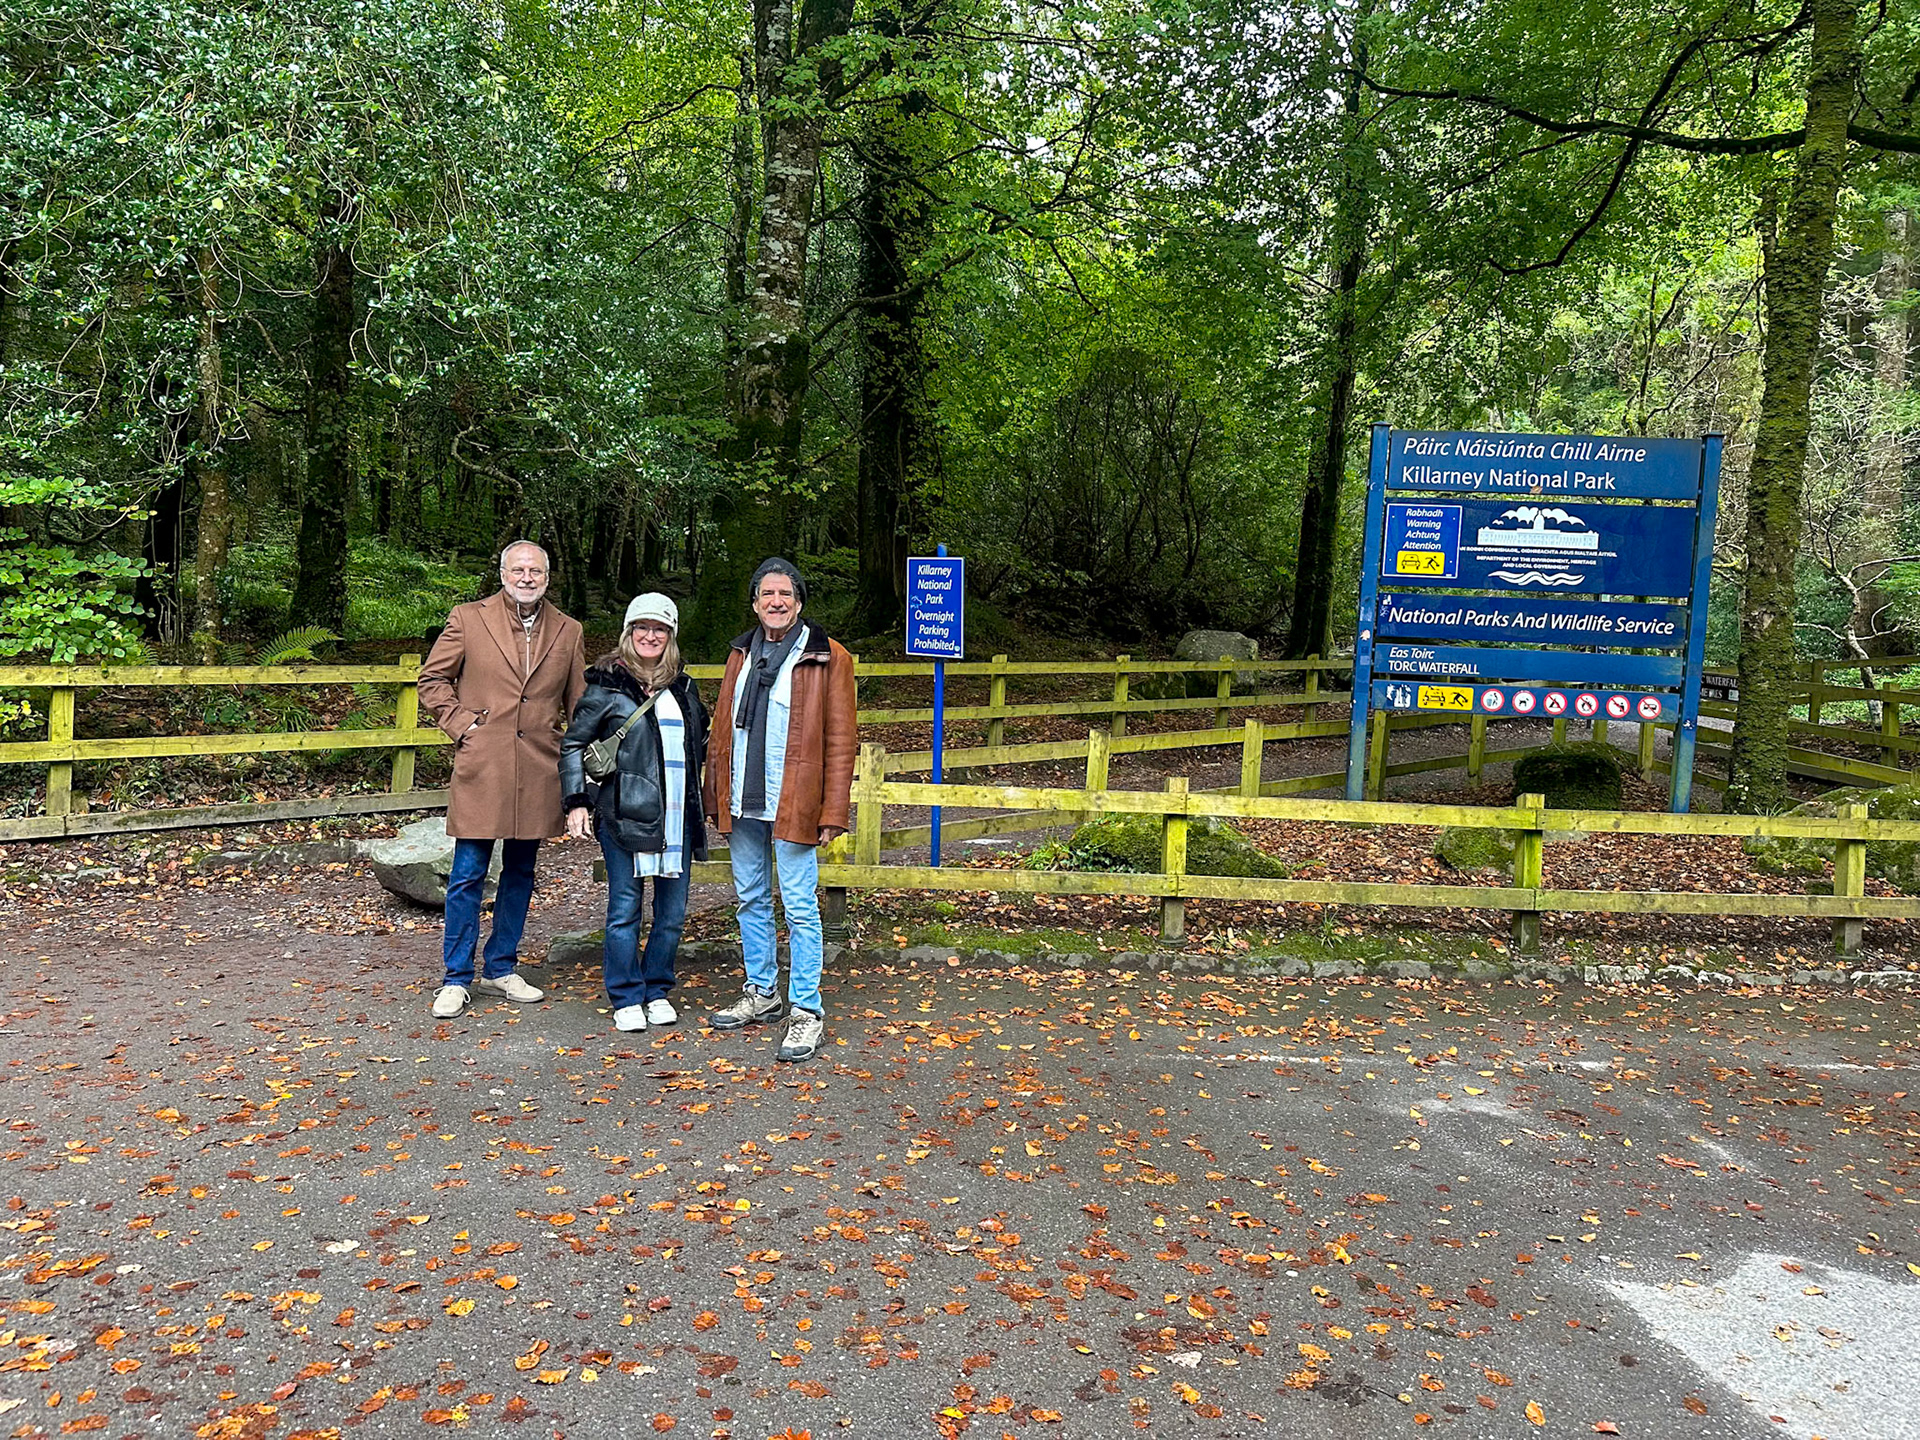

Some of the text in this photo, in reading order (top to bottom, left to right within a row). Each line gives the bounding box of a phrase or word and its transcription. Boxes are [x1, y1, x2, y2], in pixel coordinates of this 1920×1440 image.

[1403, 437, 1647, 462] Páirc Náisiúnta Chill Airne
[1402, 466, 1616, 490] Killarney National Park
[1406, 508, 1443, 518] Rabhadh
[1406, 519, 1442, 530] Warning
[1405, 530, 1440, 541] Achtung
[1402, 541, 1441, 551] Attention
[917, 564, 952, 578] Killarney
[917, 579, 952, 590] National
[925, 593, 944, 605] Park
[914, 609, 955, 624] Overnight
[1388, 607, 1675, 635] National Parks And Wildlife Service
[918, 624, 950, 638] Parking
[913, 637, 955, 651] Prohibited
[1389, 646, 1435, 659] Eas Toirc
[1388, 660, 1480, 675] TORC WATERFALL
[1705, 675, 1738, 688] WATERFAL
